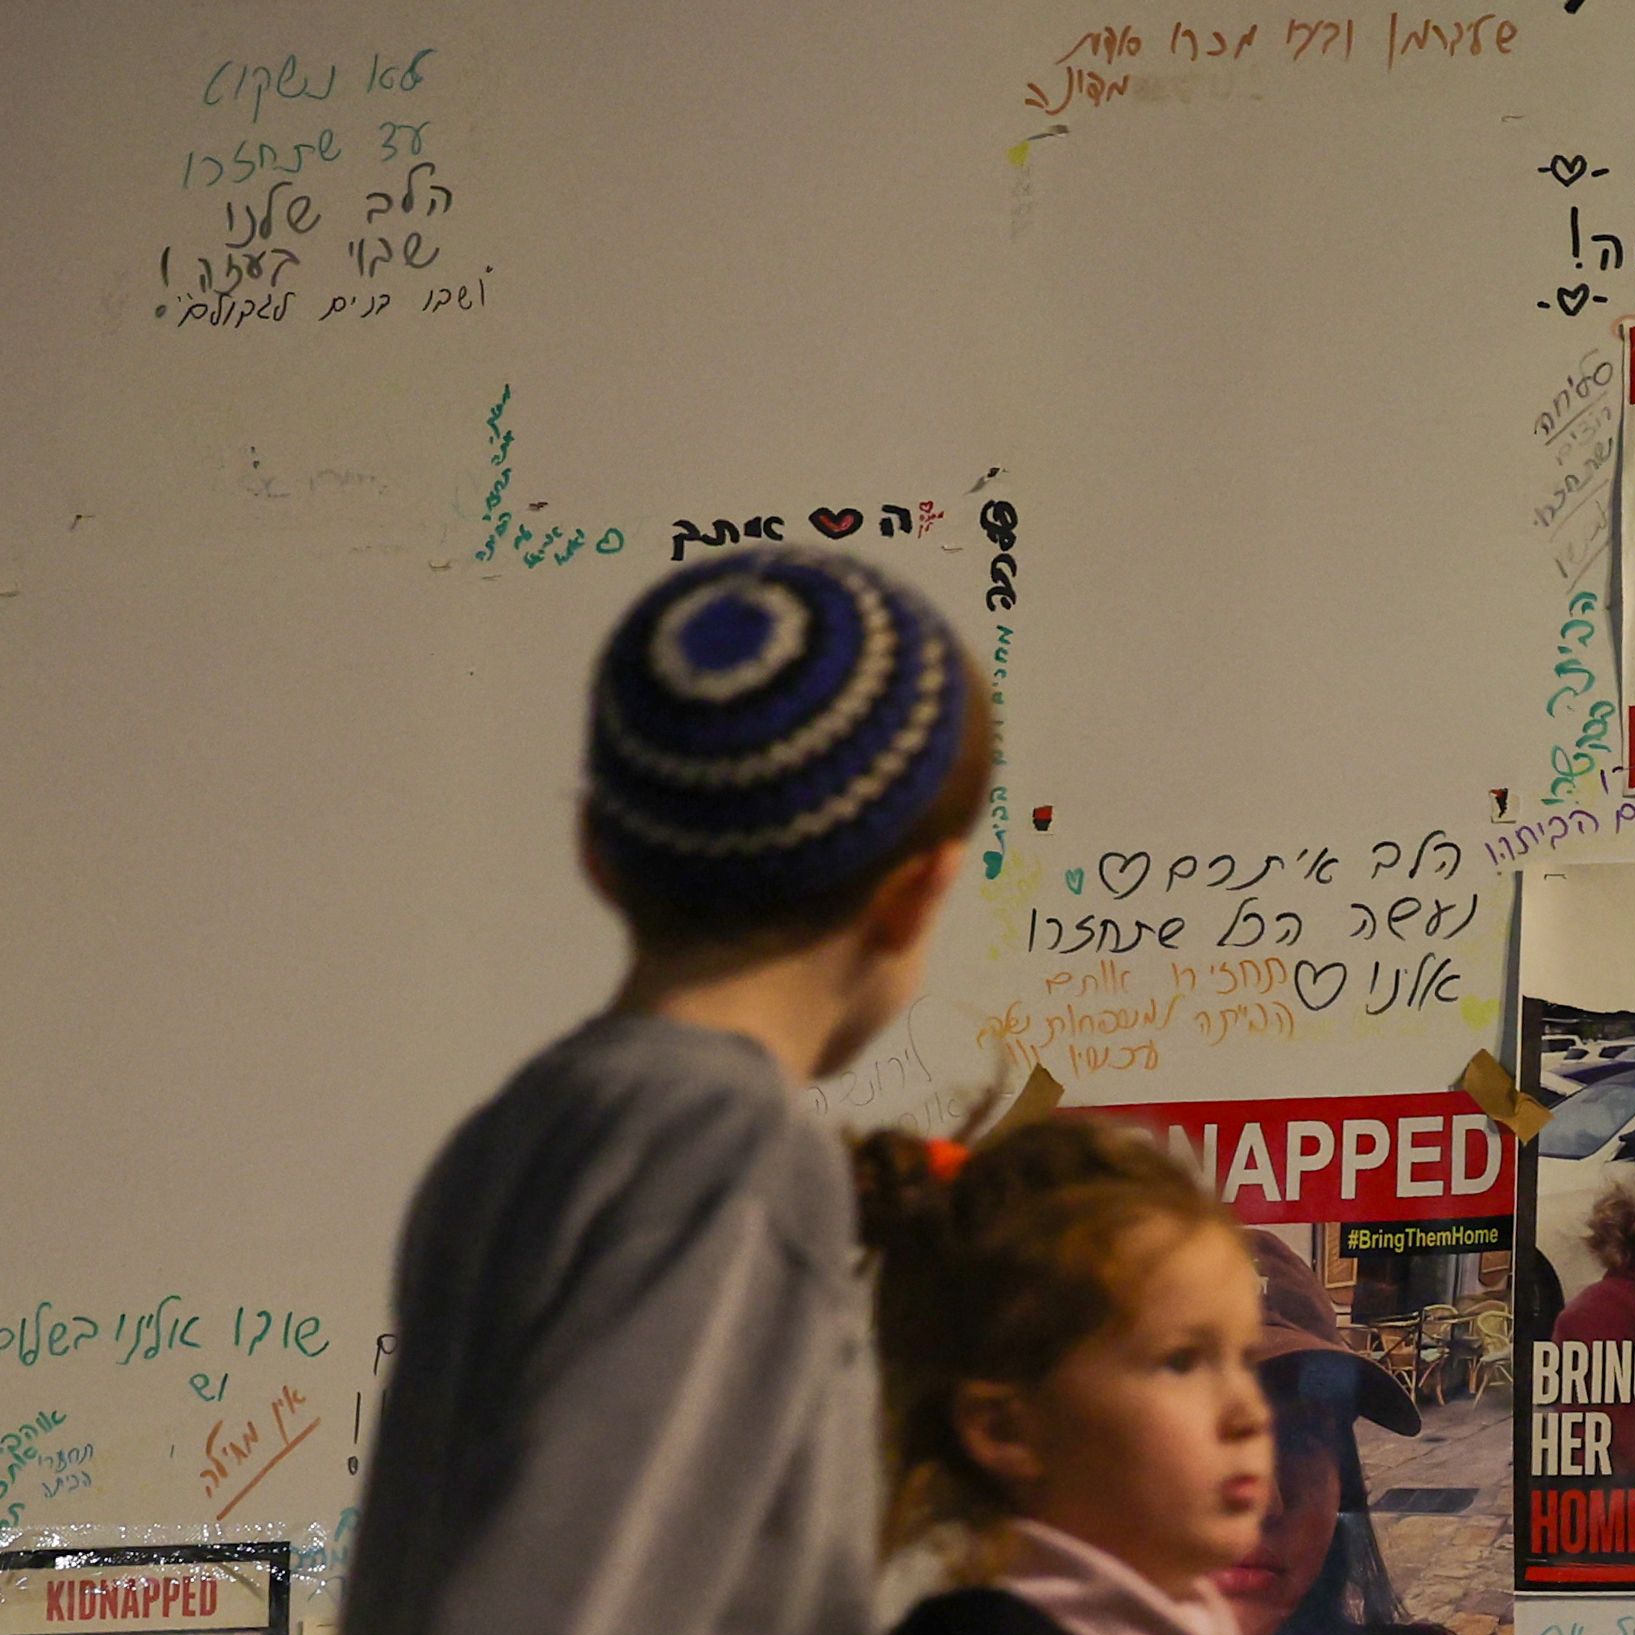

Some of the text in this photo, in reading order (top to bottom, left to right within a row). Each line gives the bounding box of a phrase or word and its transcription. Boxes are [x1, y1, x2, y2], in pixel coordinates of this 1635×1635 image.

[1372, 830, 1461, 895] הלב
[1351, 894, 1478, 940] נעשה
[1347, 1222, 1499, 1256] #BringThemHome
[46, 1576, 218, 1622] KIDNAPPED
